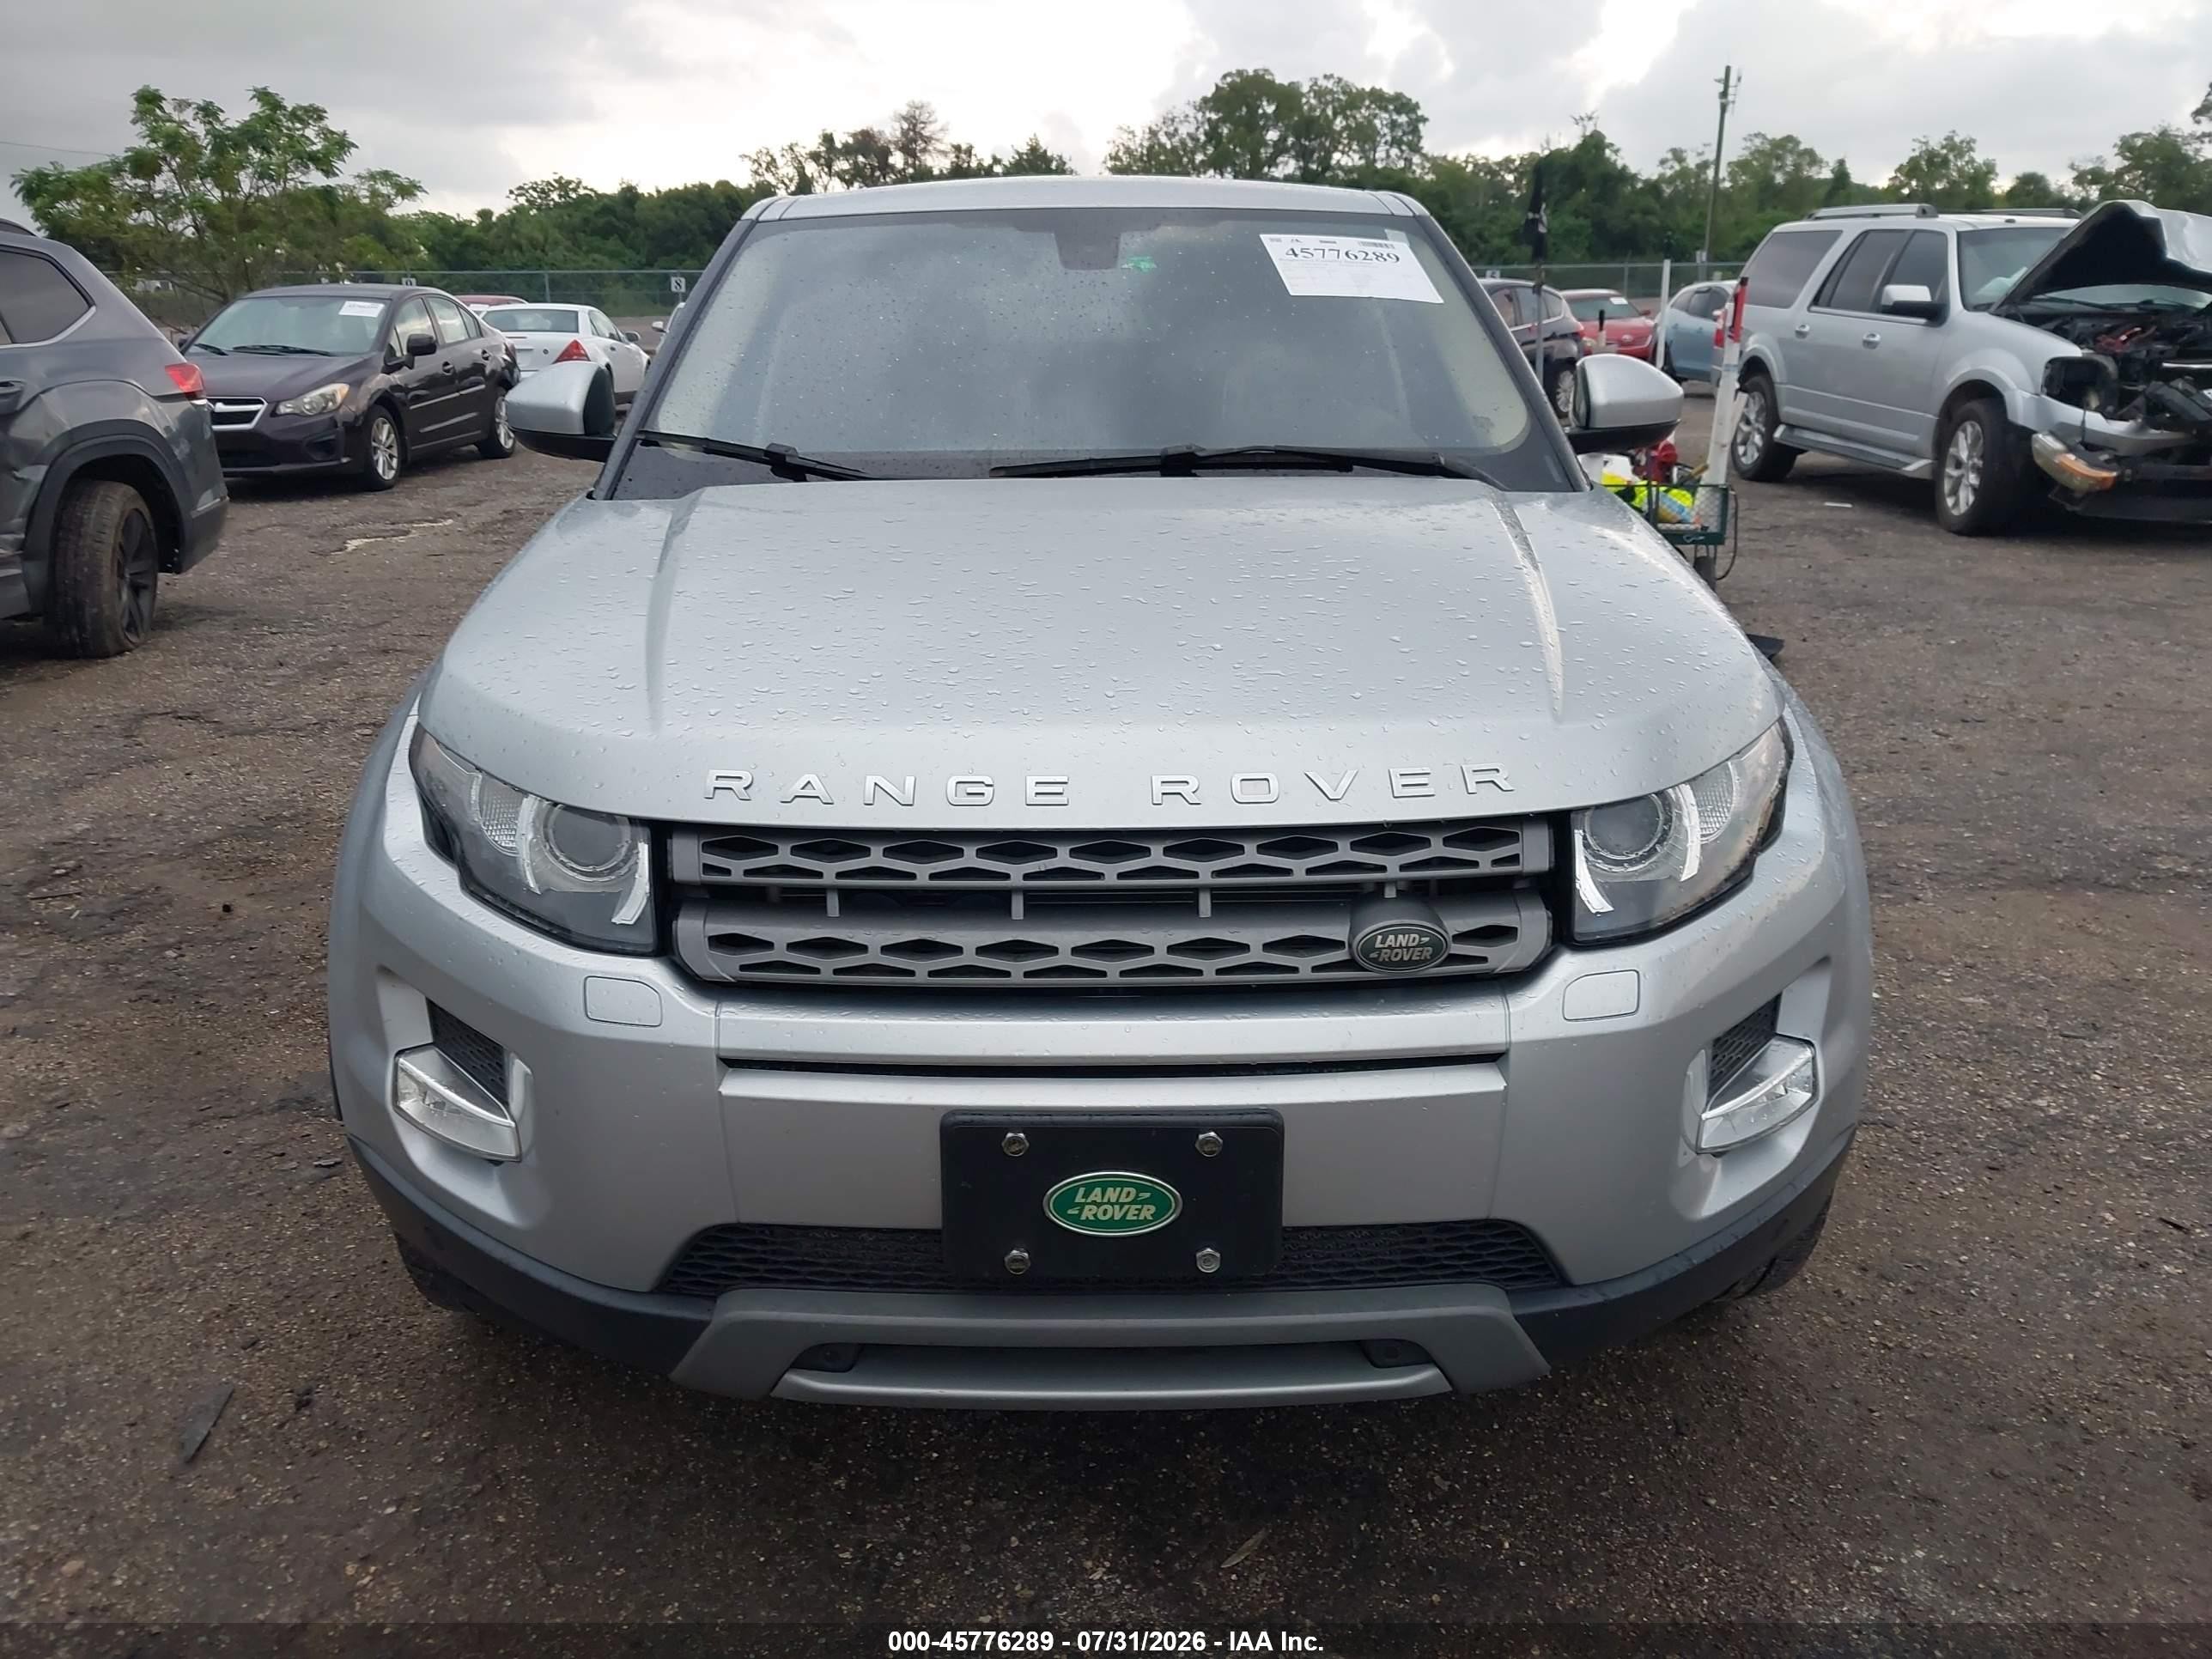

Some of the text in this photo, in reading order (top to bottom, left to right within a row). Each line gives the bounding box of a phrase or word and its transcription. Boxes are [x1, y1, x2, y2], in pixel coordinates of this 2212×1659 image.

[1285, 247, 1401, 264] 45776289
[704, 762, 1516, 806] RANGE ROVER
